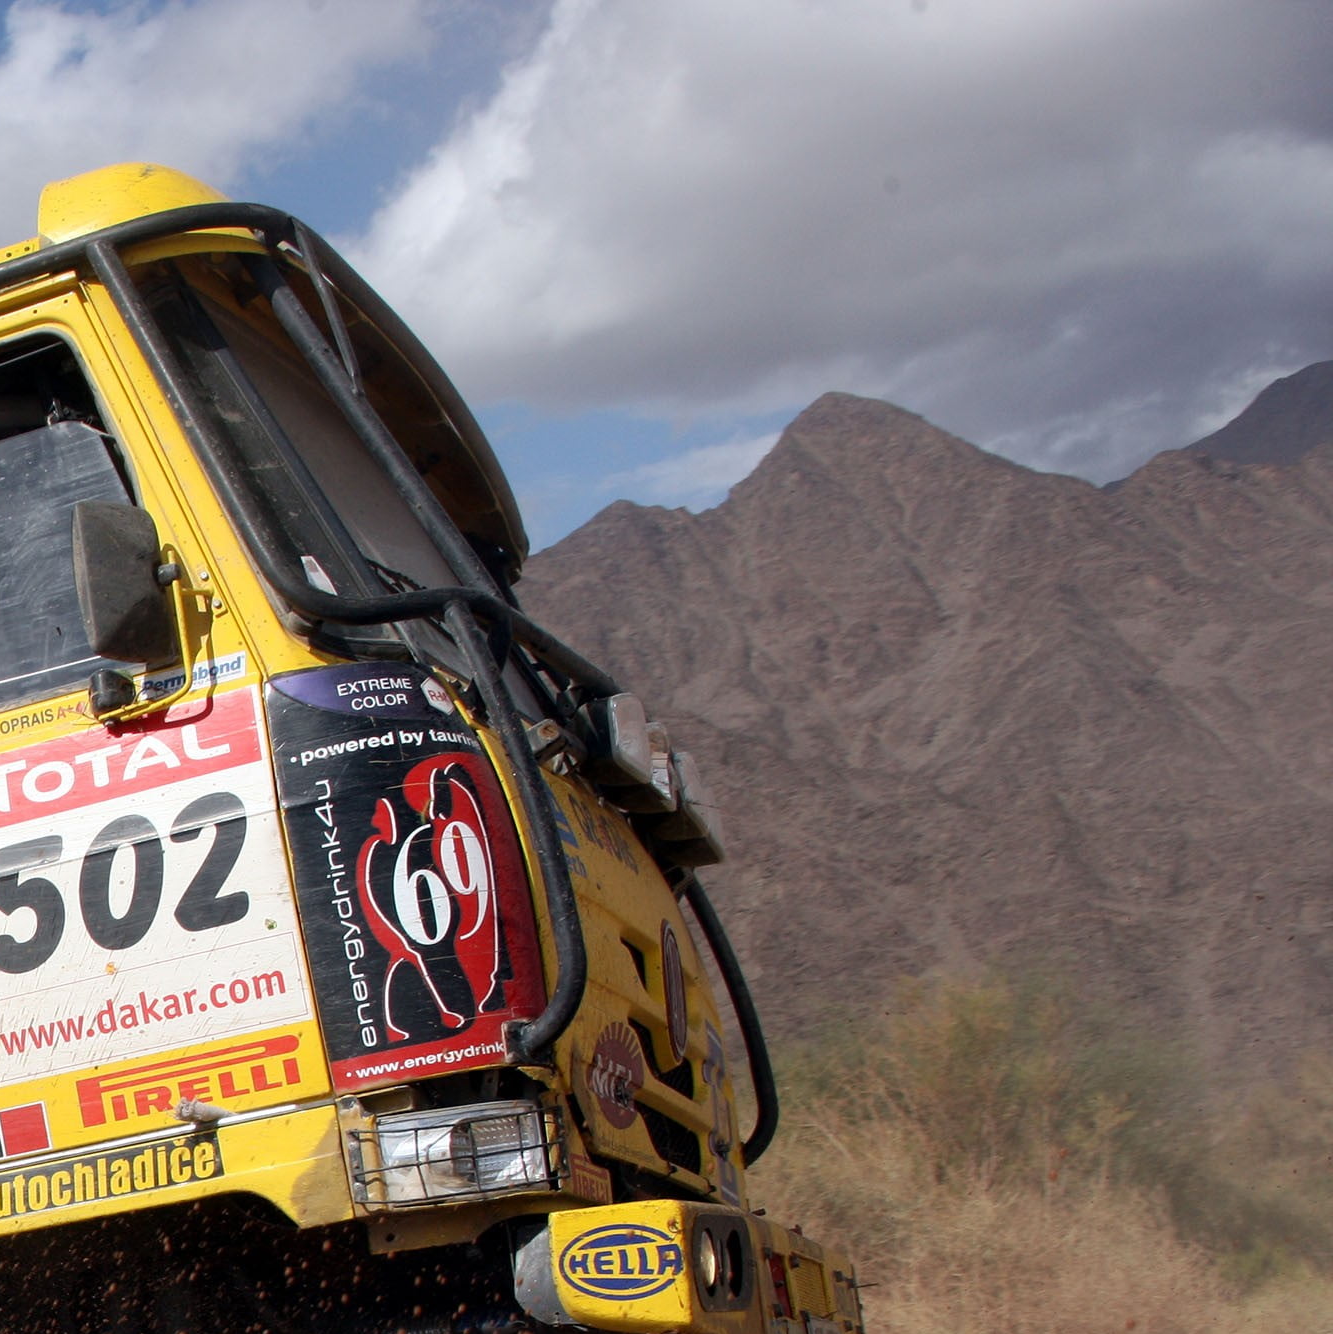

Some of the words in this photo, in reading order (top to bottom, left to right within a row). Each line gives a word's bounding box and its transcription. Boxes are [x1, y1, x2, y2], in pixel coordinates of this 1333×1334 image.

[336, 678, 412, 696] EXTREME
[351, 694, 408, 710] COLOR
[300, 732, 395, 766] powered
[398, 730, 423, 748] by
[316, 780, 377, 1046] energydrink4u
[394, 821, 487, 945] 69
[0, 968, 285, 1057] www.dakar.com
[77, 1034, 299, 1127] PIRELLI
[569, 1245, 682, 1276] HELLA
